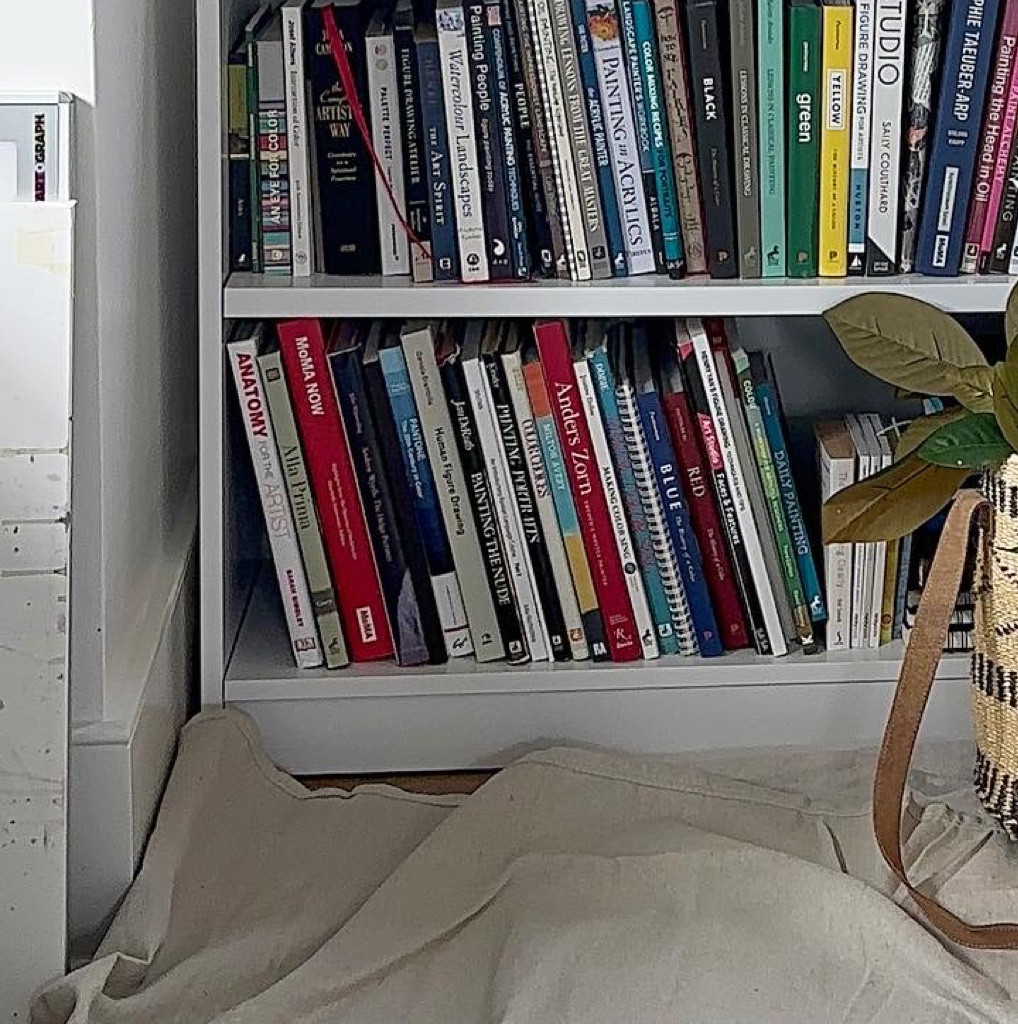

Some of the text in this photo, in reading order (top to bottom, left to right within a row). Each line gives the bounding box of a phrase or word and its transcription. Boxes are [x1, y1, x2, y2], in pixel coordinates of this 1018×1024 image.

[623, 1, 639, 54] LANDSCAPE
[858, 3, 870, 48] FIGURE
[469, 5, 491, 111] Painting People
[560, 47, 576, 92] LESSONS
[630, 56, 645, 101] PAINTER'S
[642, 41, 656, 73] COLOR
[953, 32, 980, 121] TAEUBER-ARP
[514, 83, 530, 129] PEOPLE
[646, 74, 659, 110] MIXING
[703, 78, 717, 120] BLACK
[766, 68, 774, 103] LESSONS
[831, 75, 842, 125] YELLOW
[855, 53, 868, 114] DRAWING
[330, 122, 351, 138] WAY
[380, 87, 392, 160] PALETTE PERFECT
[401, 48, 420, 184] FIGURE DRAWING ATELIER
[448, 49, 474, 218] Watercolour Landscapes
[498, 91, 516, 166] ACRYLIC PAINTING
[566, 94, 581, 125] FROM
[589, 99, 608, 166] ACRYLIC PAINTER
[636, 102, 649, 152] WORKBOOK
[651, 112, 664, 148] RECIPES
[739, 70, 752, 196] LESSONS IN CLASSICAL DRAWING
[795, 93, 812, 143] green
[975, 36, 1015, 202] Painting the Head in Oil
[574, 126, 586, 145] THE
[602, 57, 644, 246] PAINTING ACRYLICS
[881, 122, 892, 150] SALLY
[995, 126, 1013, 184] ALCHEMY
[267, 109, 281, 225] AN EYE FOR COLOR
[431, 150, 444, 177] ART
[576, 149, 590, 182] GREAT
[878, 152, 891, 214] COULTHARD
[432, 181, 447, 225] SPIRIT
[581, 186, 599, 233] MASTERS
[649, 196, 660, 231] ALBALA
[659, 168, 673, 219] PORTRAITS
[701, 351, 731, 448] HENRY FIGURE DRAWING
[410, 418, 426, 462] PANTONE
[553, 381, 596, 496] Anders Zorn
[701, 419, 712, 435] Art
[706, 437, 719, 464] Studio
[235, 353, 298, 594] ANATOMY FOR THE ARTIST SARAH
[434, 427, 465, 536] Human Figure Drawing
[496, 404, 540, 544] PAINTING PORTRAITS
[542, 423, 566, 490] MILTON AVERY
[281, 444, 313, 530] Alla Prima
[295, 336, 375, 641] MoMA NOW MoMA
[660, 463, 682, 511] BLUE
[686, 466, 705, 498] RED
[716, 473, 730, 498] Faces
[774, 450, 809, 555] DAILY PAINTING
[602, 466, 631, 559] MAKING COLOR SING
[725, 508, 740, 545] Features
[470, 472, 511, 606] PAINTING THE NUDE
